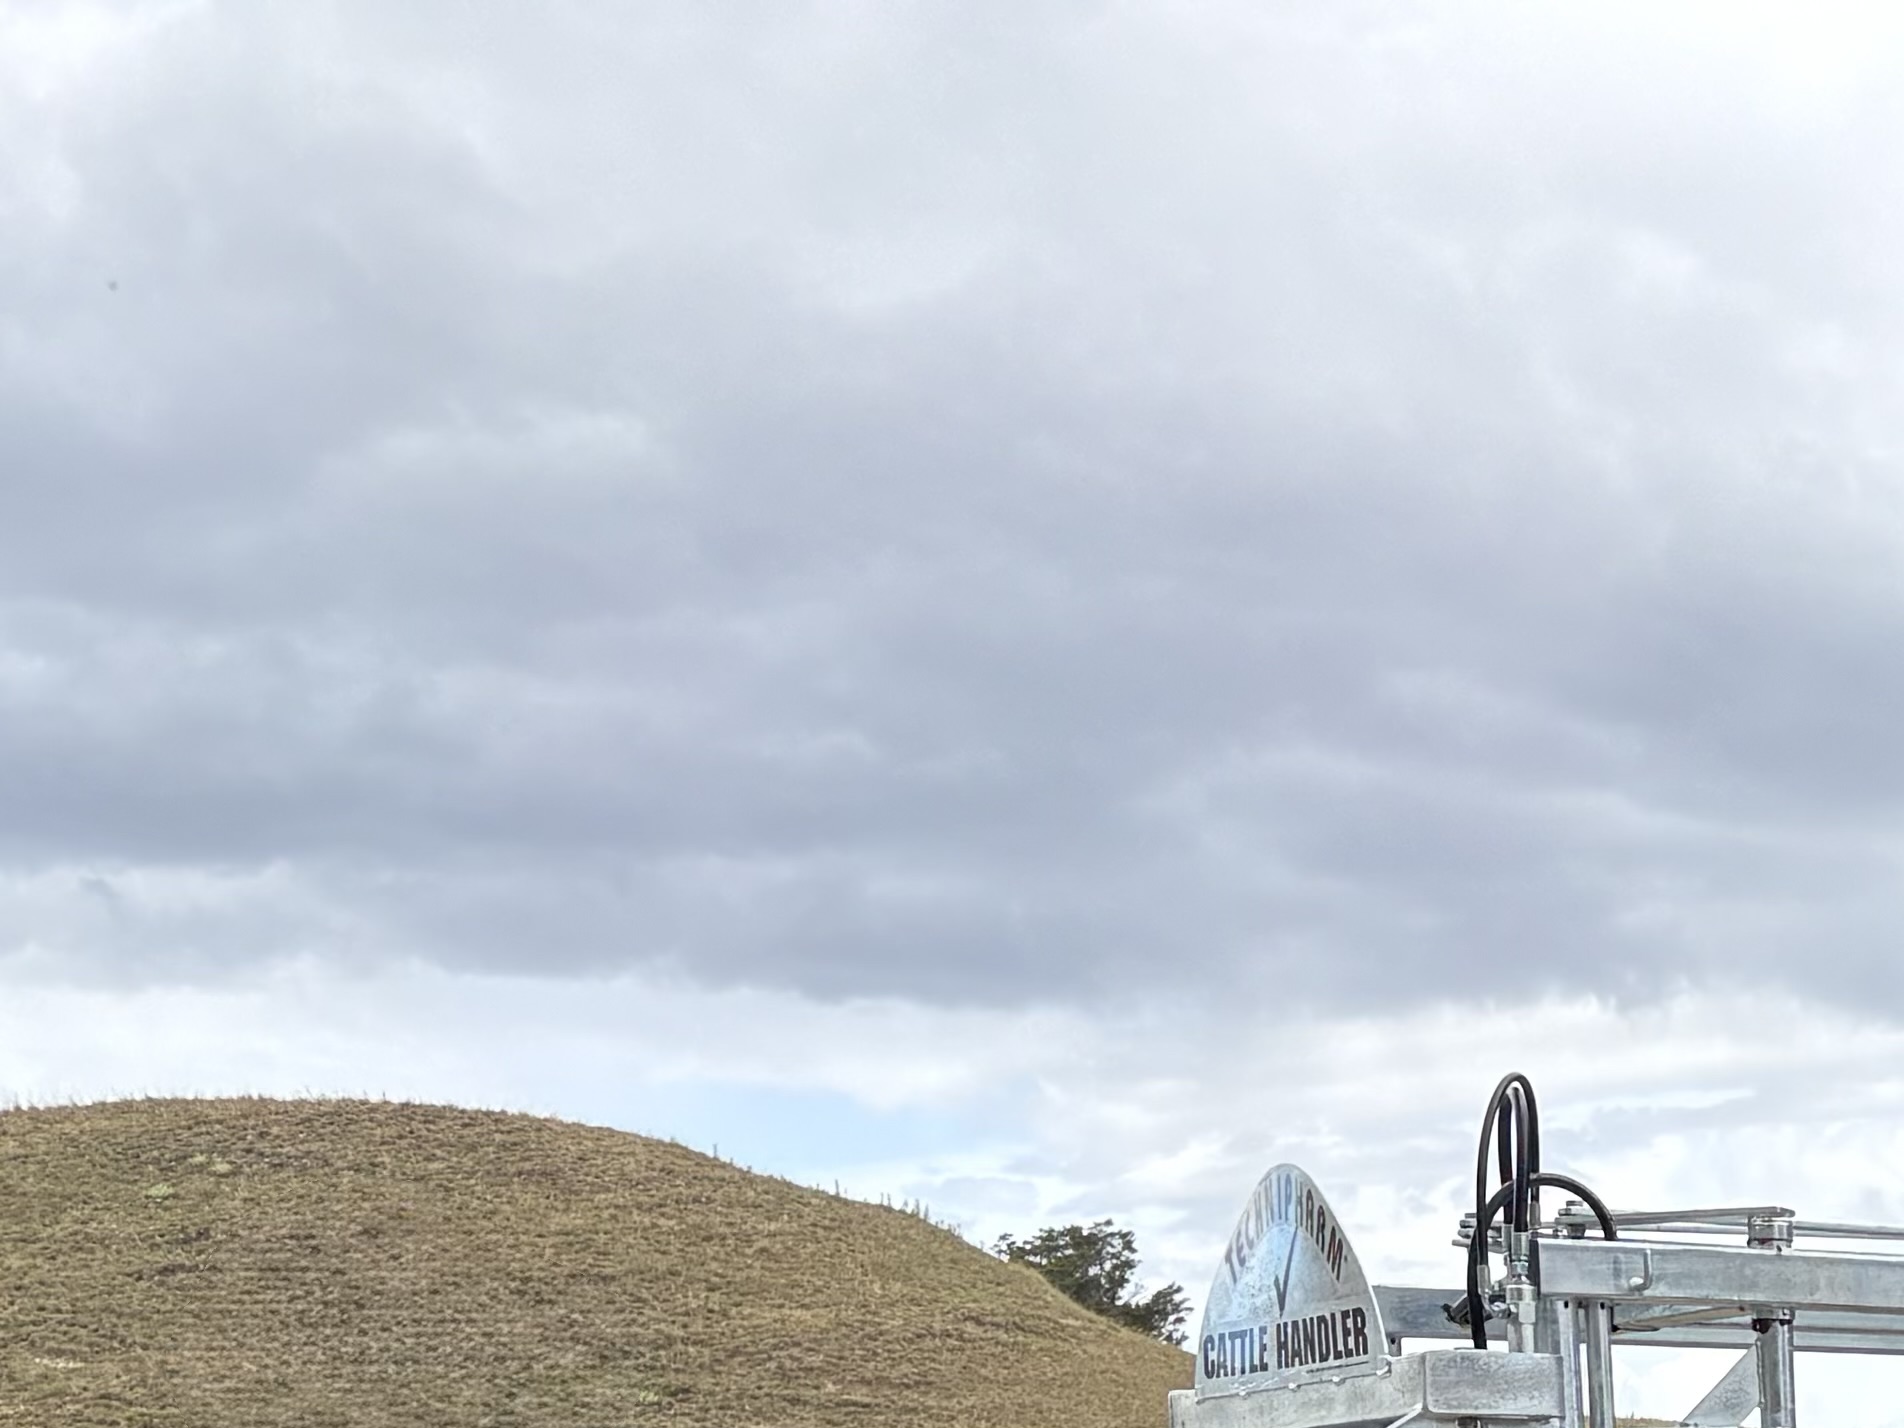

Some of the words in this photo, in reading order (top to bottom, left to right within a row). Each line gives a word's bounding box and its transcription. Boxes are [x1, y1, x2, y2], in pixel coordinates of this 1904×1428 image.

[1224, 1173, 1344, 1285] TECHNIPHARM
[1203, 1325, 1269, 1380] CATTLE
[1276, 1307, 1369, 1370] HANDLER
